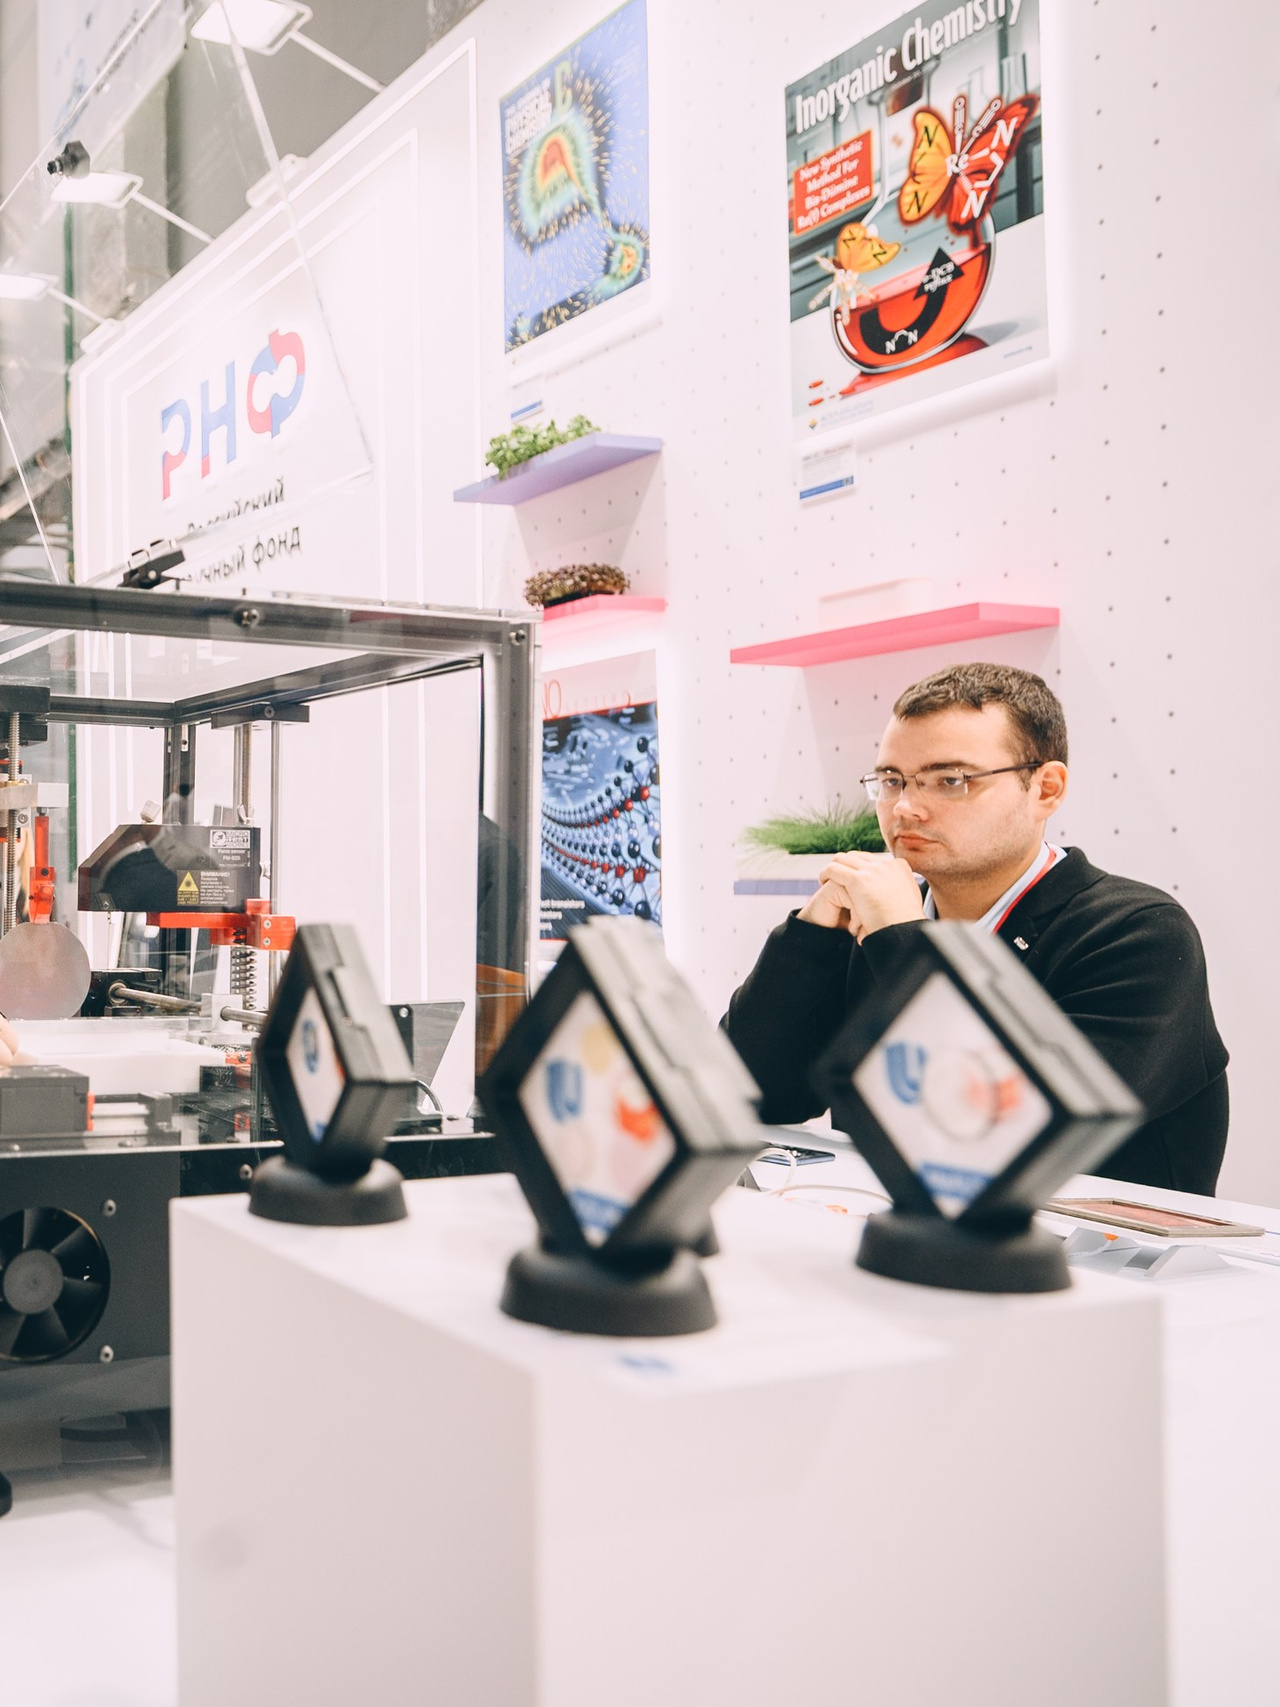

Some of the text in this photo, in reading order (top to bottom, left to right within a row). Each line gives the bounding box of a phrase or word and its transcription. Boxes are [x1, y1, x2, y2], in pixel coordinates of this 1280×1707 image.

[795, 45, 897, 135] Inorganic
[806, 158, 860, 194] Method For
[161, 329, 306, 501] РНФ
